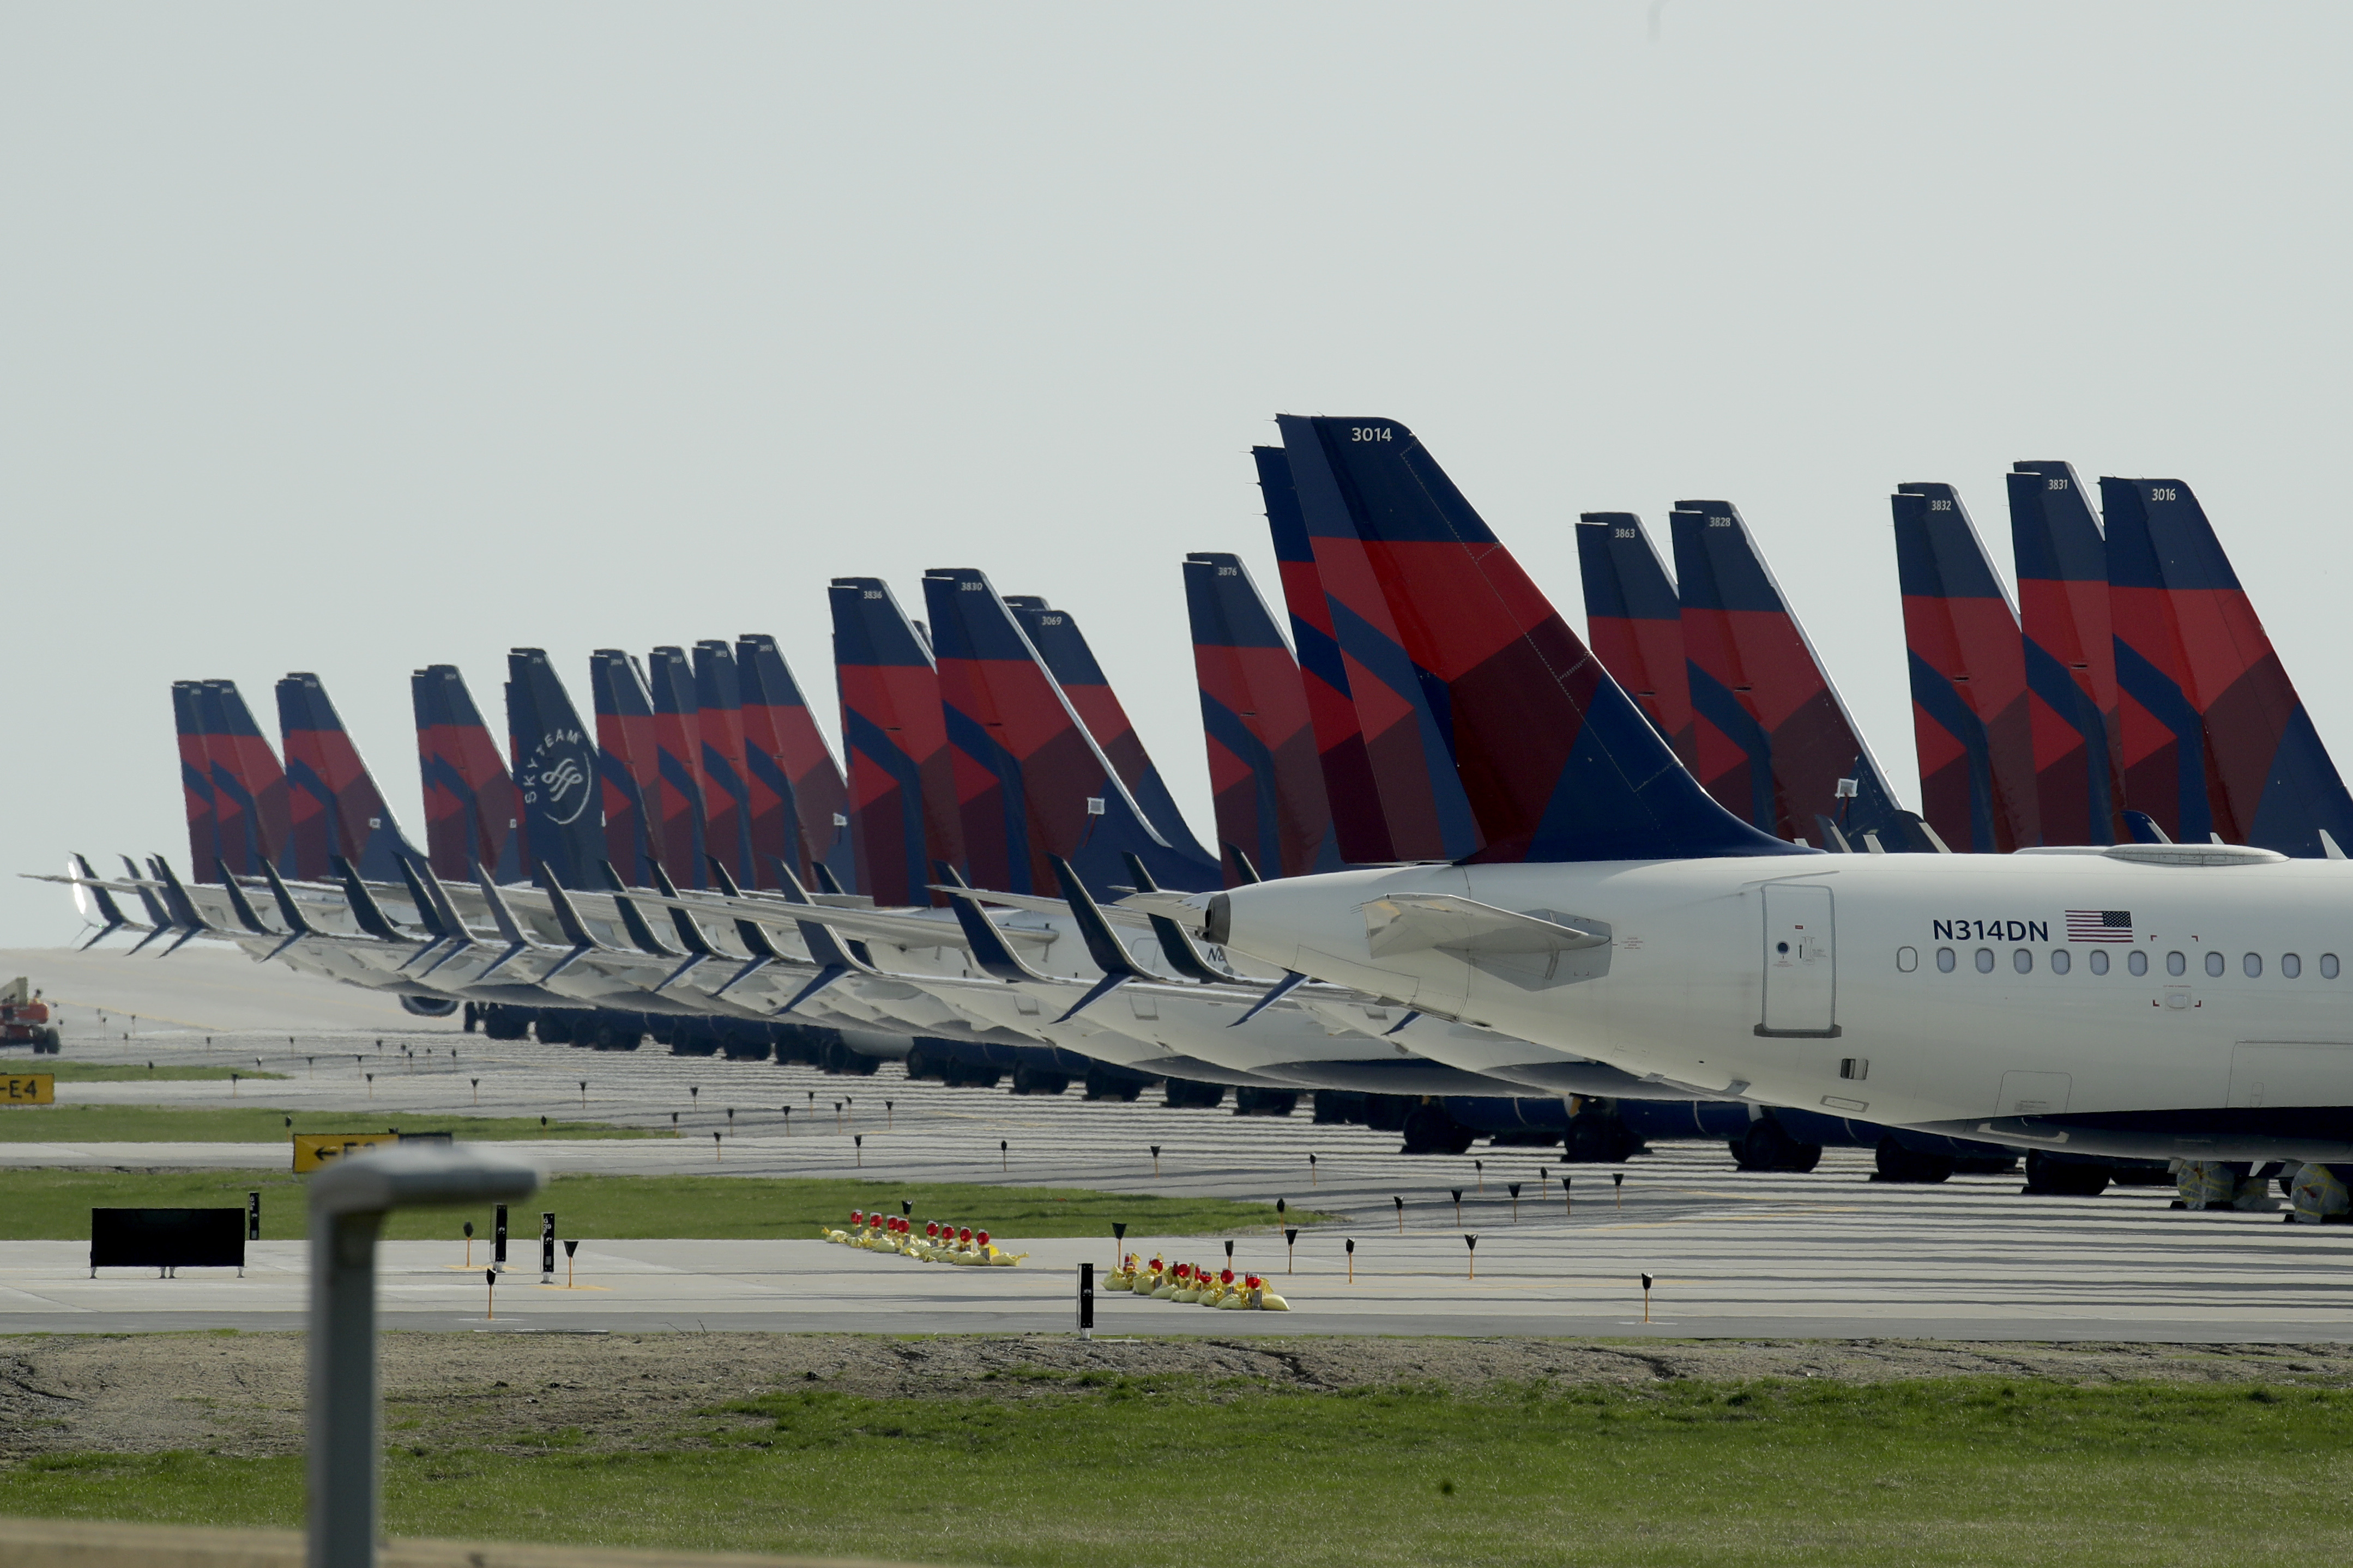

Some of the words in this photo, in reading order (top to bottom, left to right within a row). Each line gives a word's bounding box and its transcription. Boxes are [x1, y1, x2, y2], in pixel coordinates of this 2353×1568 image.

[1352, 427, 1392, 442] 3014
[2048, 479, 2067, 490] 3831
[2152, 488, 2176, 501] 3016
[1931, 500, 1951, 511] 3832
[1709, 517, 1731, 528] 3828
[1615, 528, 1636, 538] 3863
[961, 582, 983, 591] 3830
[1042, 616, 1062, 626] 3069
[523, 729, 581, 804] SKYTEAM
[1933, 919, 2049, 942] N314DN
[9, 1079, 37, 1099] E4
